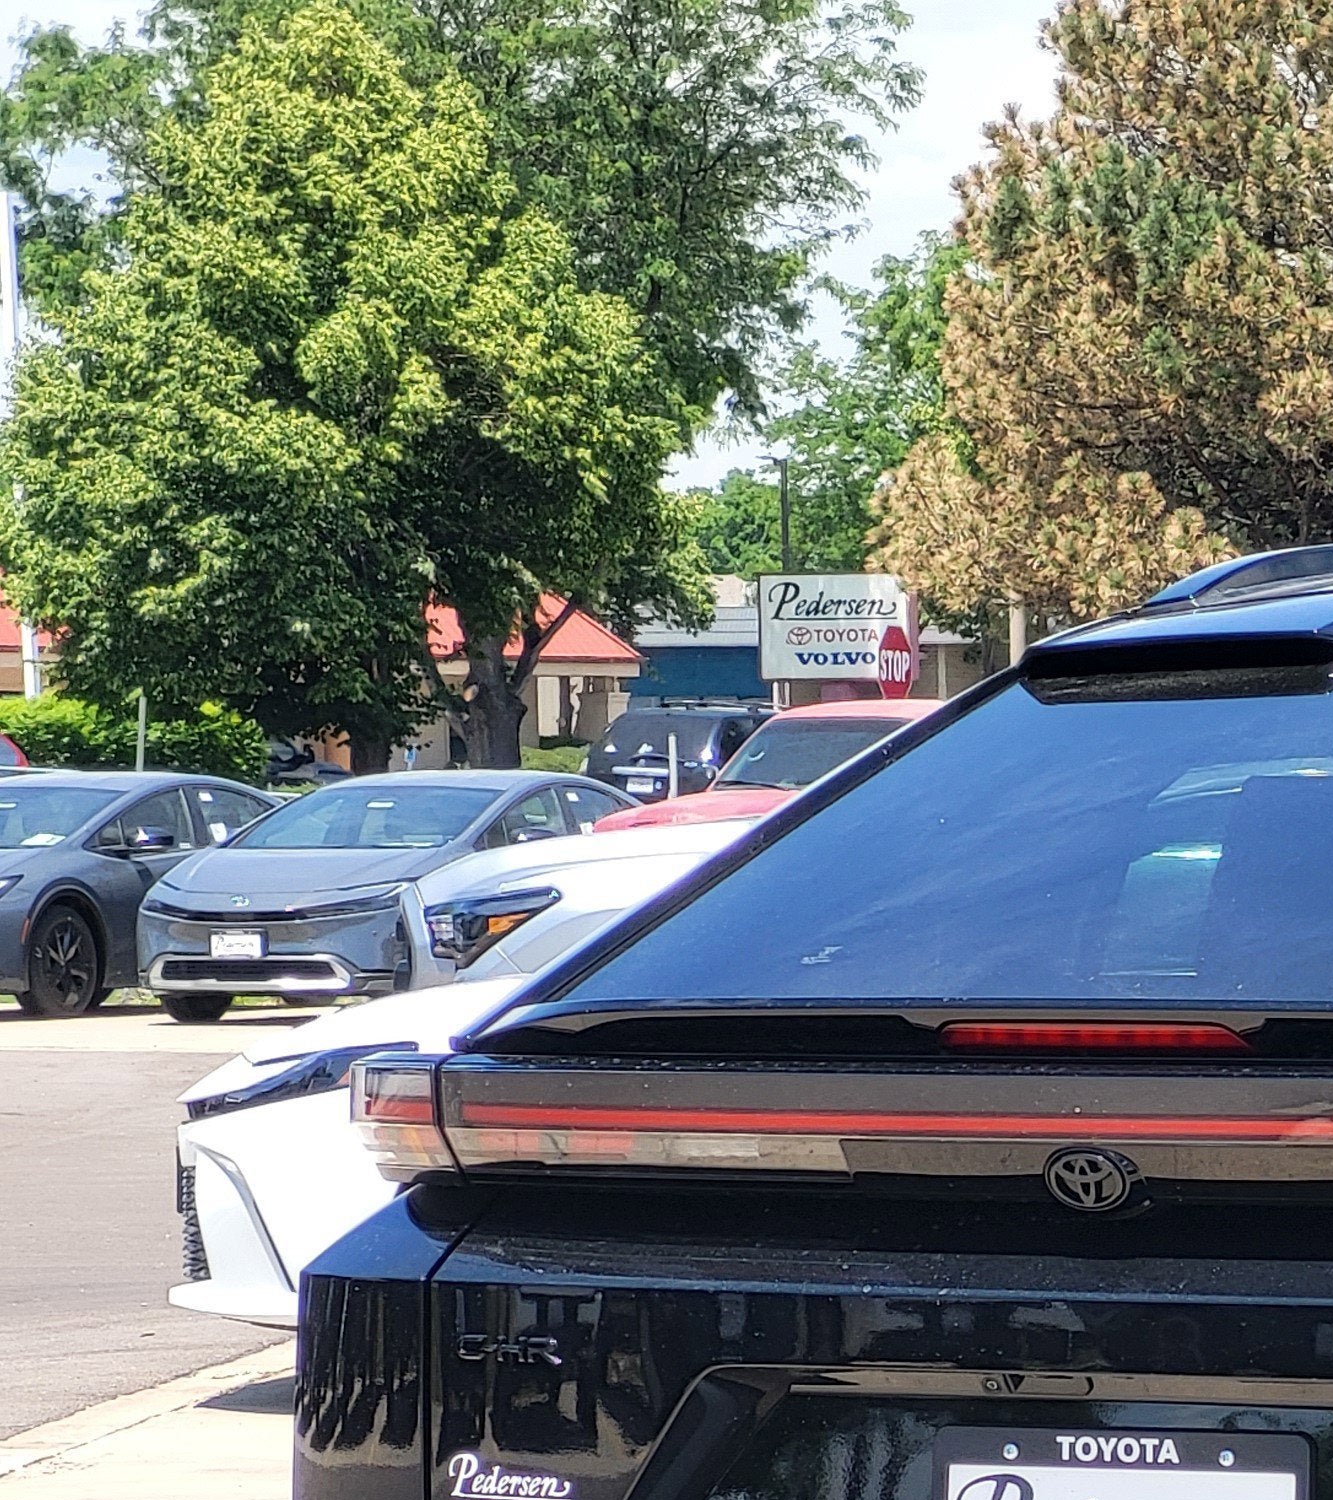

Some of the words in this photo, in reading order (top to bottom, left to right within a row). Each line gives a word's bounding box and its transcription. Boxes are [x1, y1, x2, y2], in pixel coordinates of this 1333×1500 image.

[768, 581, 897, 620] Pedersen
[814, 627, 879, 643] TOYOTA
[795, 651, 876, 665] VOLVO
[879, 649, 910, 683] STOP
[1056, 1436, 1180, 1465] TOYOTA
[448, 1453, 571, 1500] Pedersen
